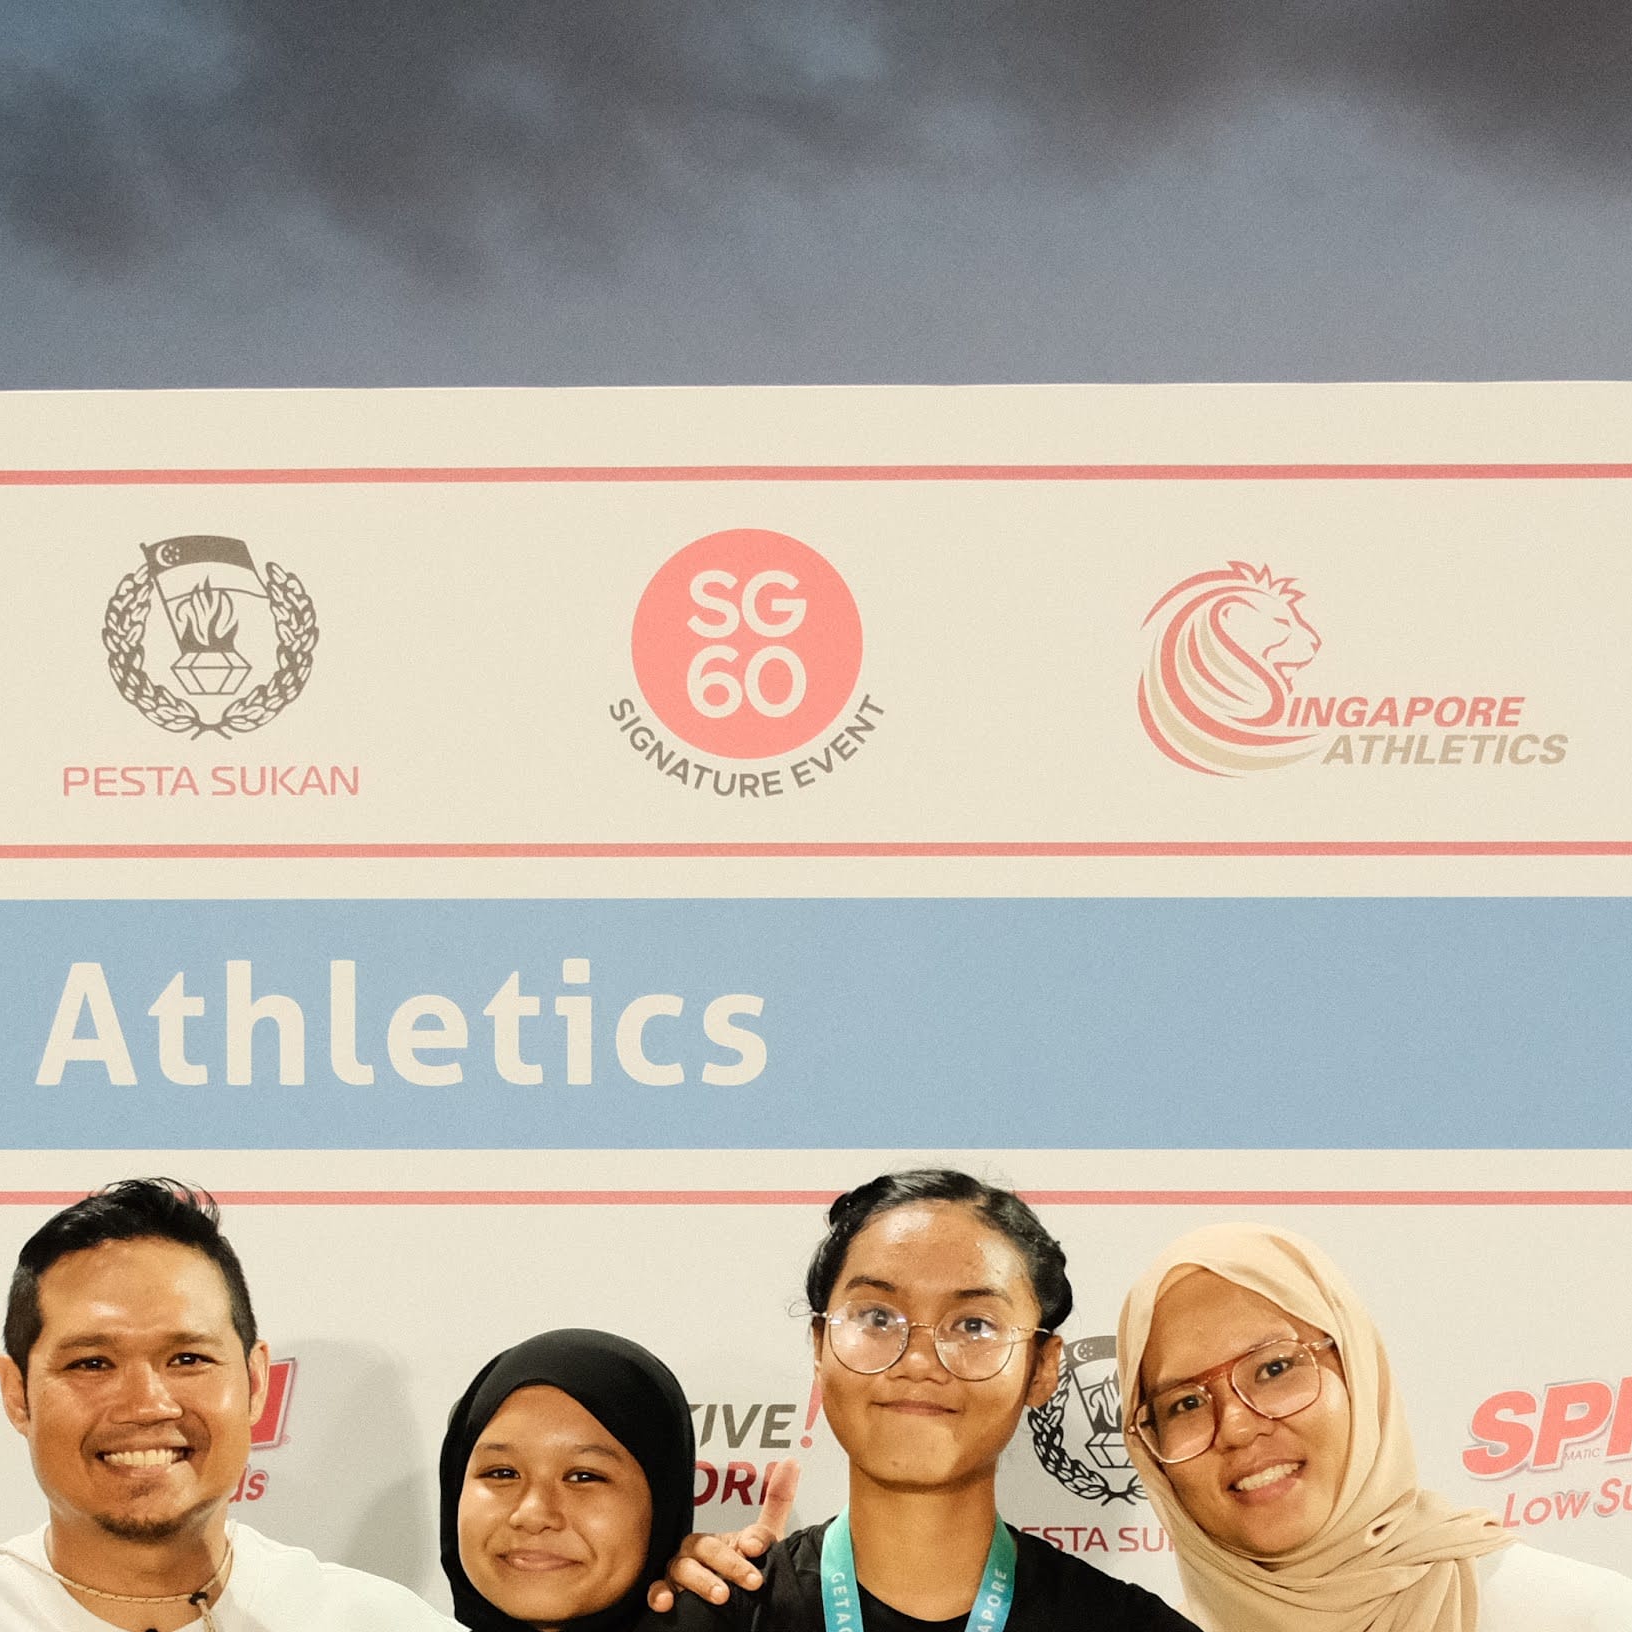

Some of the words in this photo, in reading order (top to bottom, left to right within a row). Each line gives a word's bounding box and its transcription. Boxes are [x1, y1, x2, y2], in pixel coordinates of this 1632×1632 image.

[687, 569, 807, 638] SG
[686, 644, 807, 719] 60
[609, 698, 784, 798] SIGNATURE
[791, 694, 885, 788] EVENT
[1322, 733, 1567, 765] ATHLETICS
[63, 765, 201, 797] PESTA
[212, 765, 359, 797] SUKAN
[35, 958, 768, 1087] Athletics
[1501, 1492, 1591, 1528] Low
